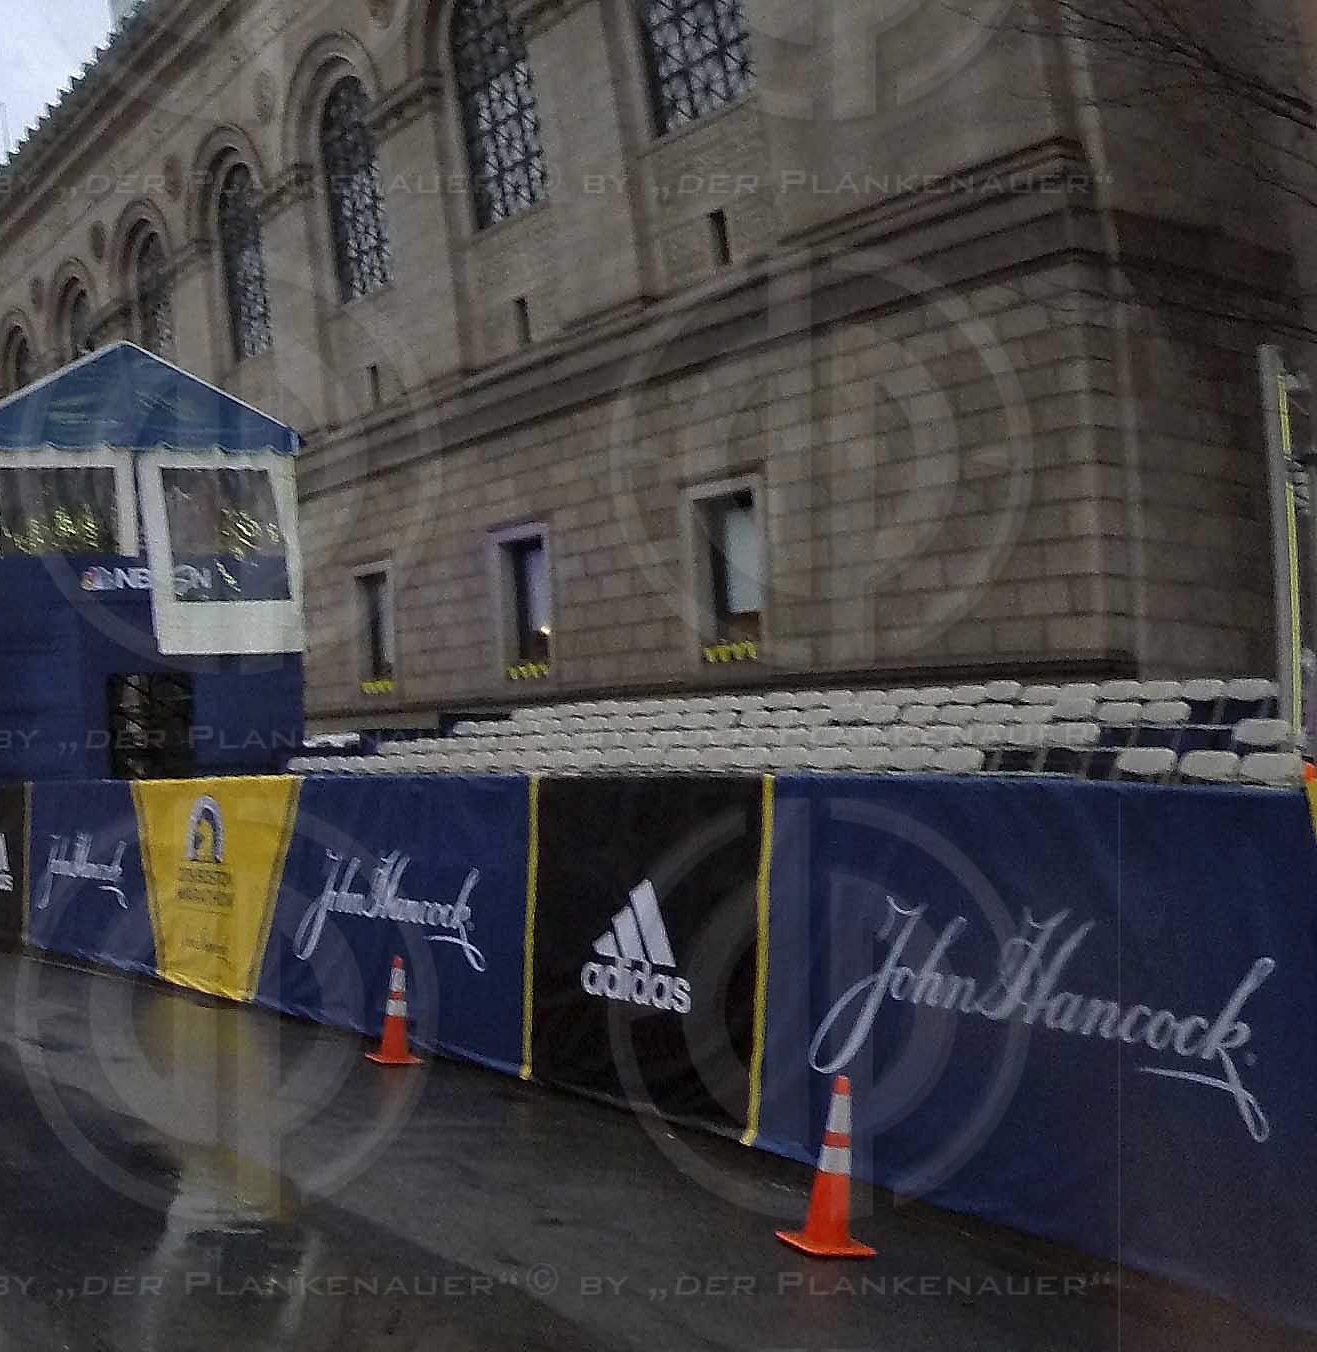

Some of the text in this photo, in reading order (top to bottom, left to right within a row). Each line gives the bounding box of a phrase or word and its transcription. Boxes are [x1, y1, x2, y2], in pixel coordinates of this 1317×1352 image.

[580, 956, 692, 1014] adidas
[809, 895, 1276, 1143] John Hancock
